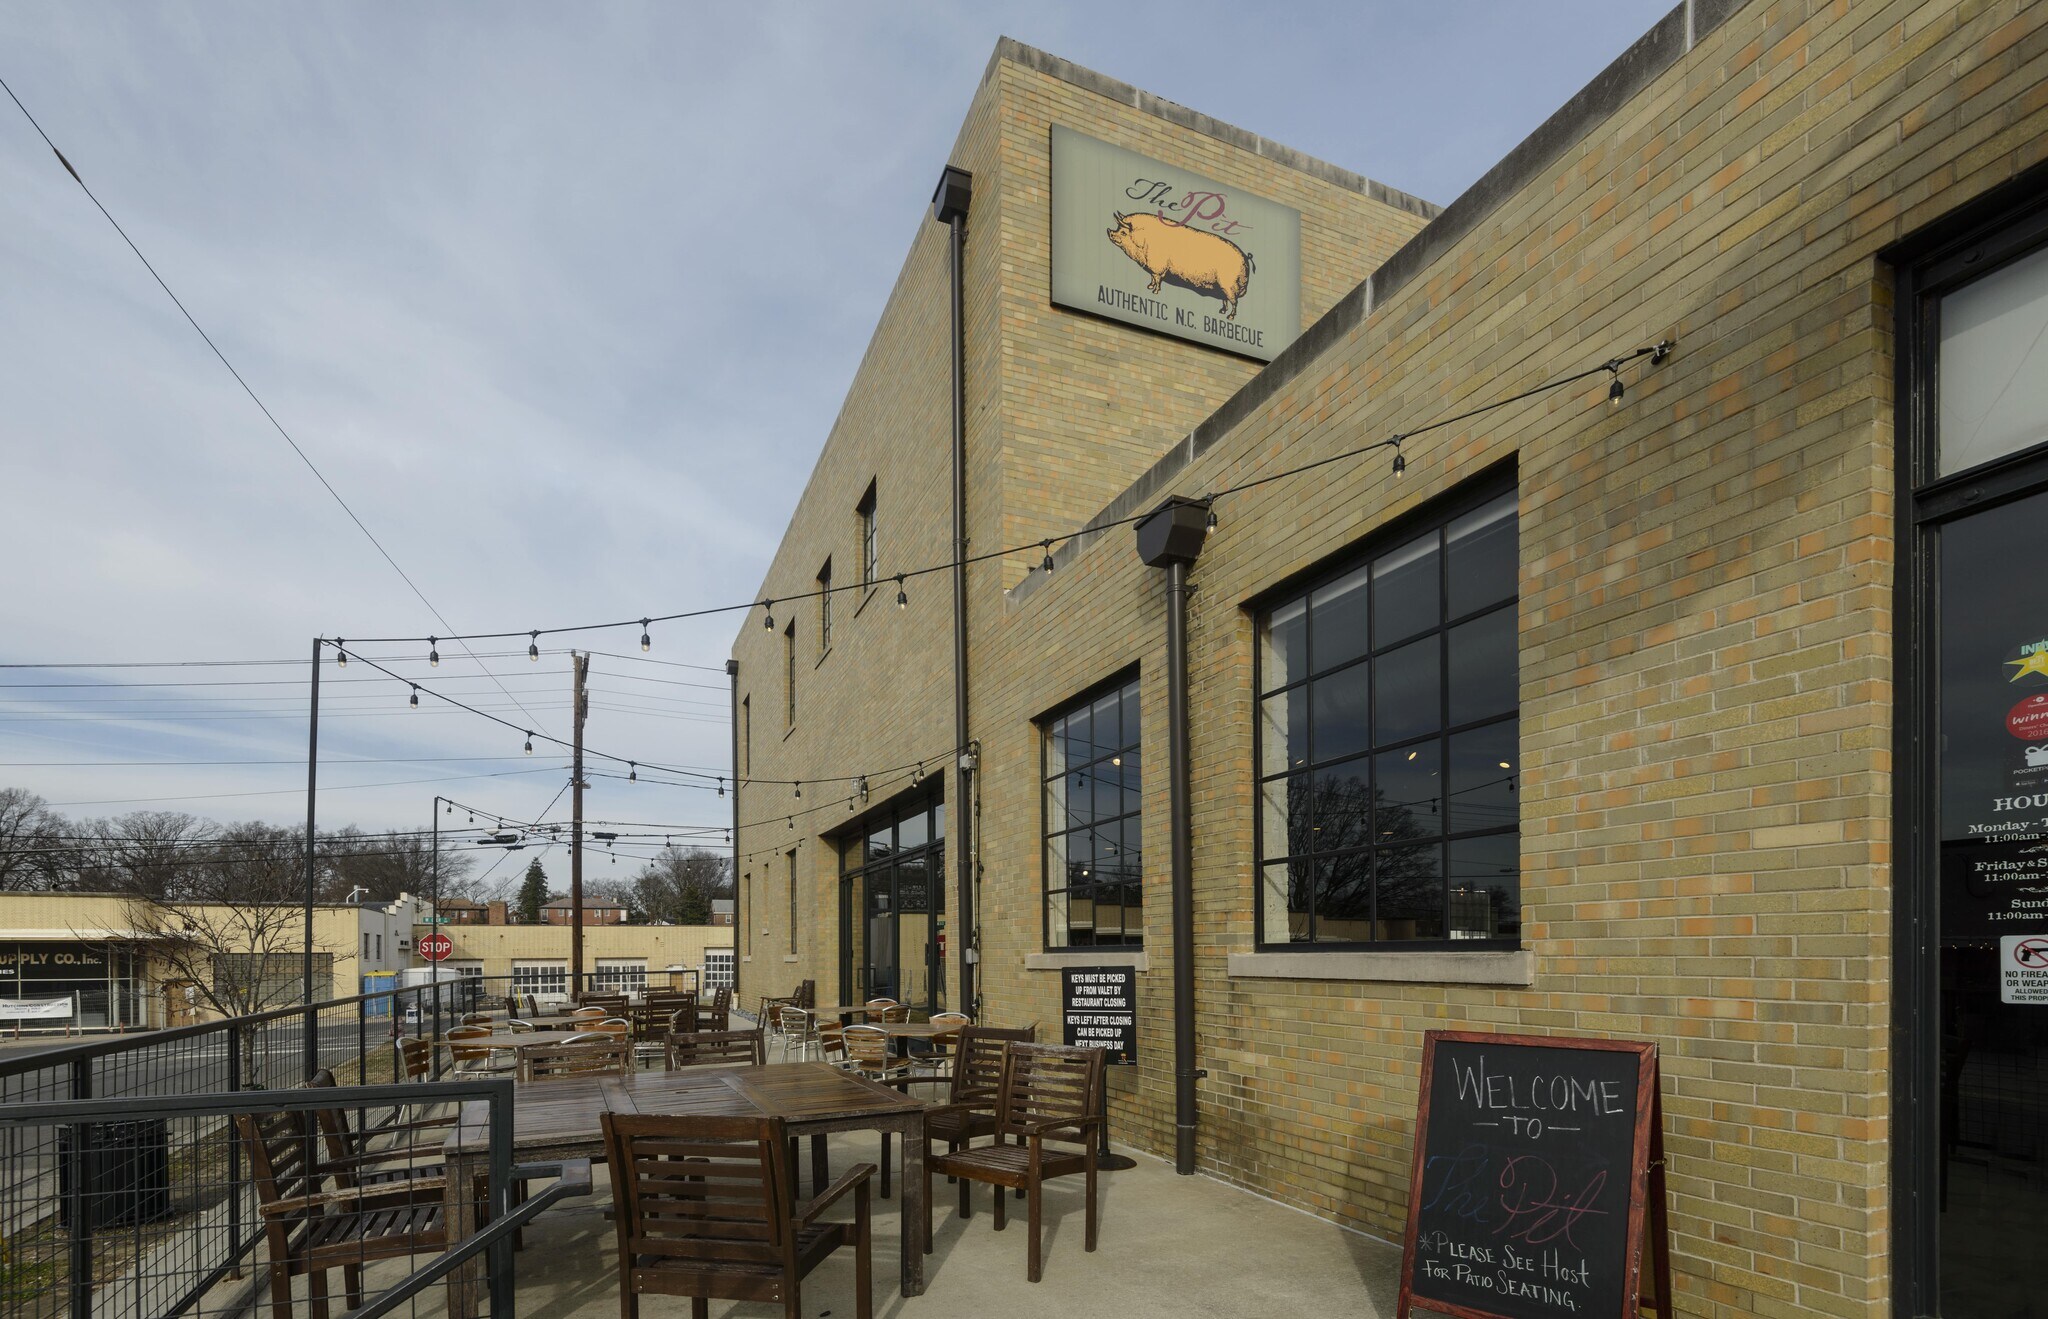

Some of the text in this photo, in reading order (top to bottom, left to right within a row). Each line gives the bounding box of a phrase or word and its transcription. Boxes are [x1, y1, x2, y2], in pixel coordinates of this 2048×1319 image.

[1126, 178, 1253, 236] The Pit
[1098, 284, 1264, 348] AUTHENTIC N.C. BARBECUE
[1968, 821, 2030, 834] Monday
[1974, 860, 2026, 872] Friday
[421, 942, 450, 952] STOP
[82, 954, 102, 964] Inc.
[1071, 973, 1126, 983] KEYS MUST BE PICKED
[2006, 979, 2019, 987] OR
[1075, 986, 1121, 995] UP FROM VALET BY
[1072, 998, 1126, 1007] RESTAURANT CLOSING
[1067, 1015, 1131, 1025] KEYS LEFT AFTER CLOSING
[1077, 1028, 1122, 1037] CAN BE PICKED UP
[1089, 1040, 1113, 1050] BUSINESS
[1114, 1041, 1124, 1050] DAY
[1452, 1055, 1624, 1116] WELCOME
[1502, 1115, 1542, 1139] TO
[1424, 1144, 1609, 1252] The Pit
